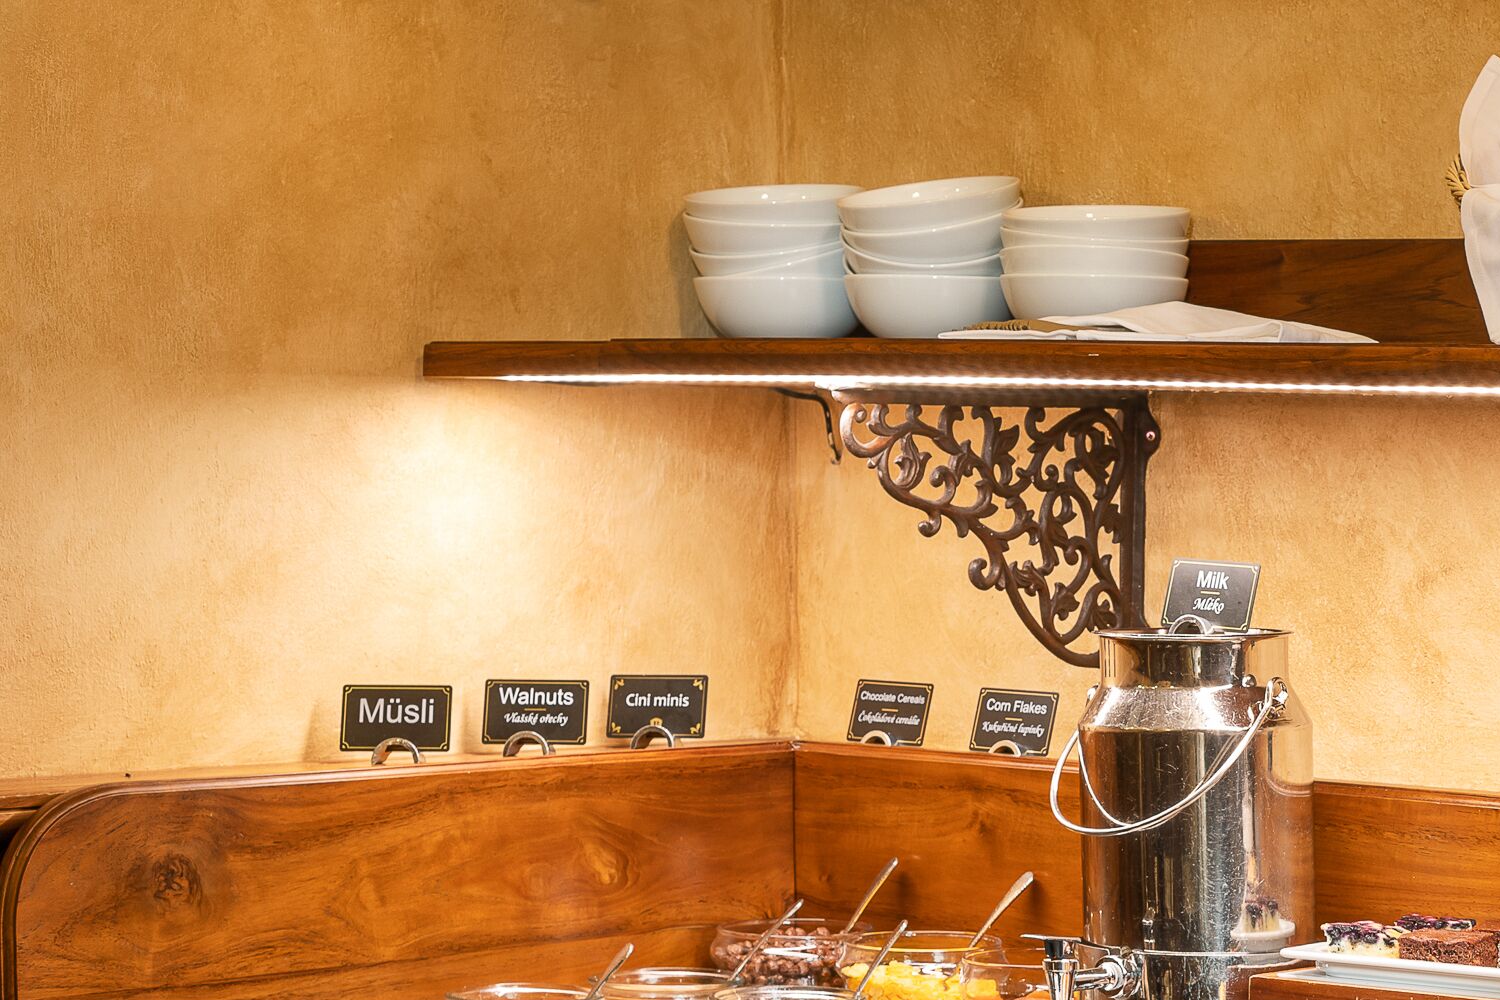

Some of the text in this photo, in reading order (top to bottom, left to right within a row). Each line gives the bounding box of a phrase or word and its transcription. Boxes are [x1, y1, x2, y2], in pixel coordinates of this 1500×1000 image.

[1196, 570, 1230, 589] Milk
[1193, 597, 1225, 615] Mléko
[499, 687, 574, 705] Walnuts
[625, 693, 690, 707] Cini minis
[860, 690, 926, 704] Chocolate Cereals
[358, 698, 435, 724] Müsli
[986, 698, 1048, 715] Corn Flakes
